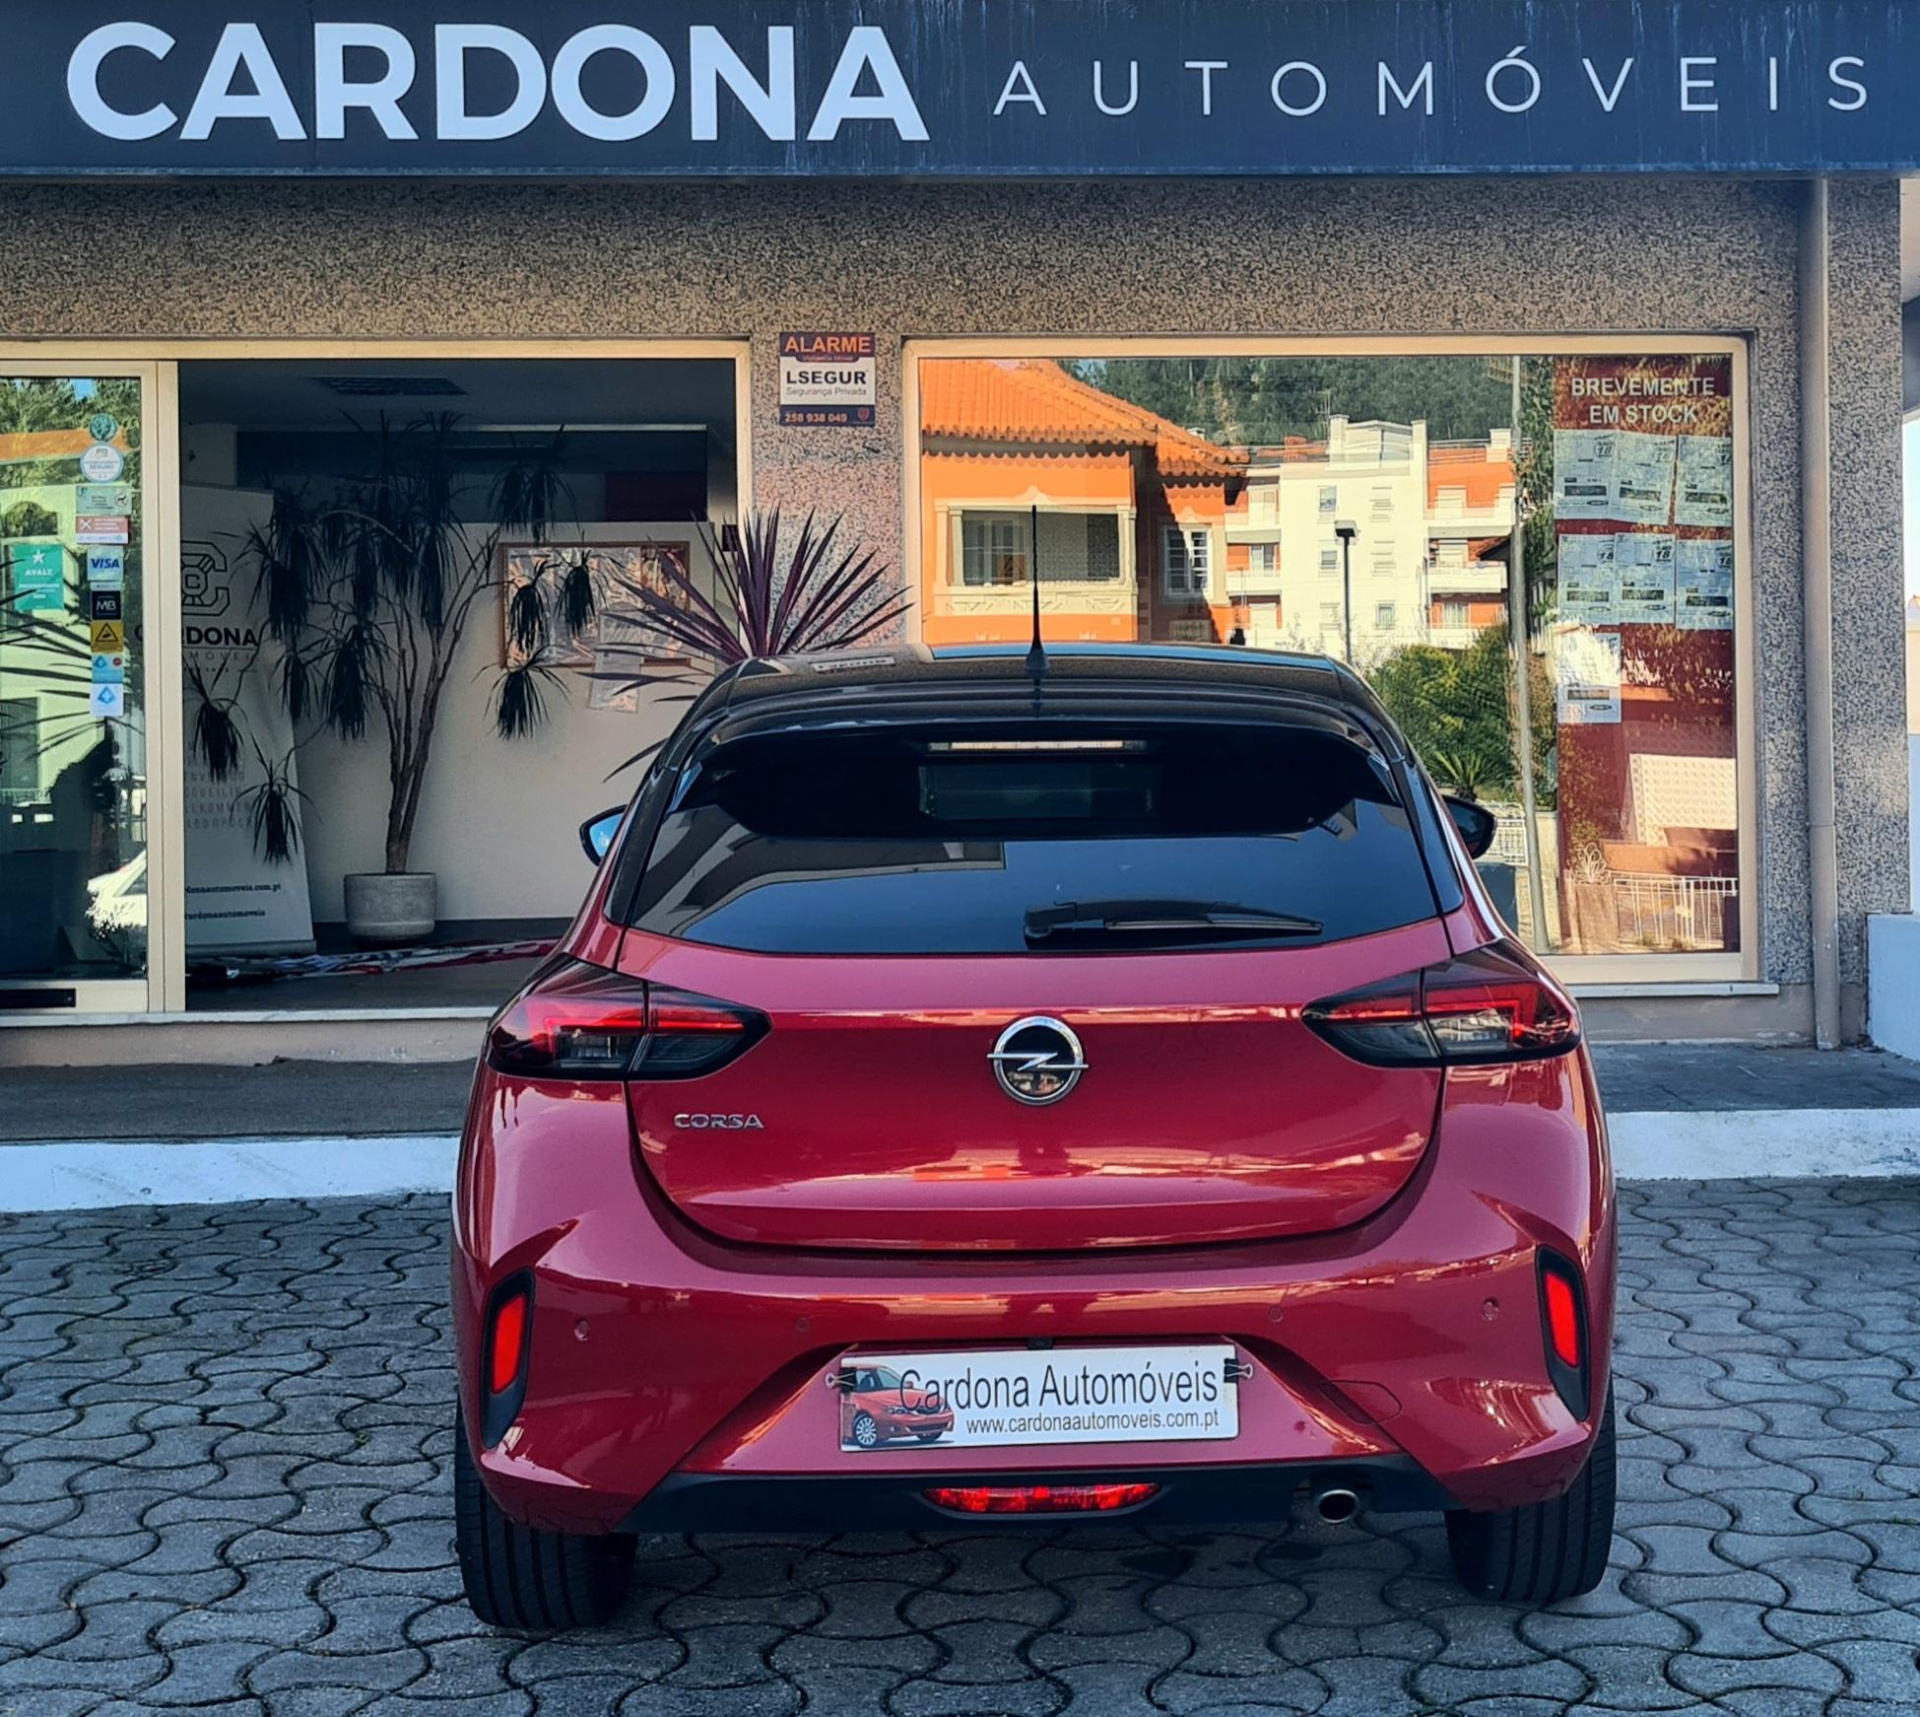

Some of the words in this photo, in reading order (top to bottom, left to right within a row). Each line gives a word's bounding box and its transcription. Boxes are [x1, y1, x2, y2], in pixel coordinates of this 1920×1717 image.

[67, 21, 930, 141] CARDONA
[993, 45, 1867, 116] AUTOMÓVEIS
[784, 336, 871, 353] ALARME
[786, 370, 867, 385] LSEGUR
[1571, 376, 1715, 396] BREVEMENTE
[786, 386, 832, 397] Segurança
[834, 386, 868, 396] Privada
[1589, 404, 1619, 424] EM
[1625, 403, 1698, 424] STOCK
[90, 558, 120, 569] VISA
[96, 600, 117, 612] MB
[673, 1113, 765, 1129] CORSA
[900, 1367, 1029, 1411] Cardona
[1039, 1360, 1218, 1407] Automóveis
[966, 1408, 1219, 1434] www.cardonaautomoveis.com.pt
